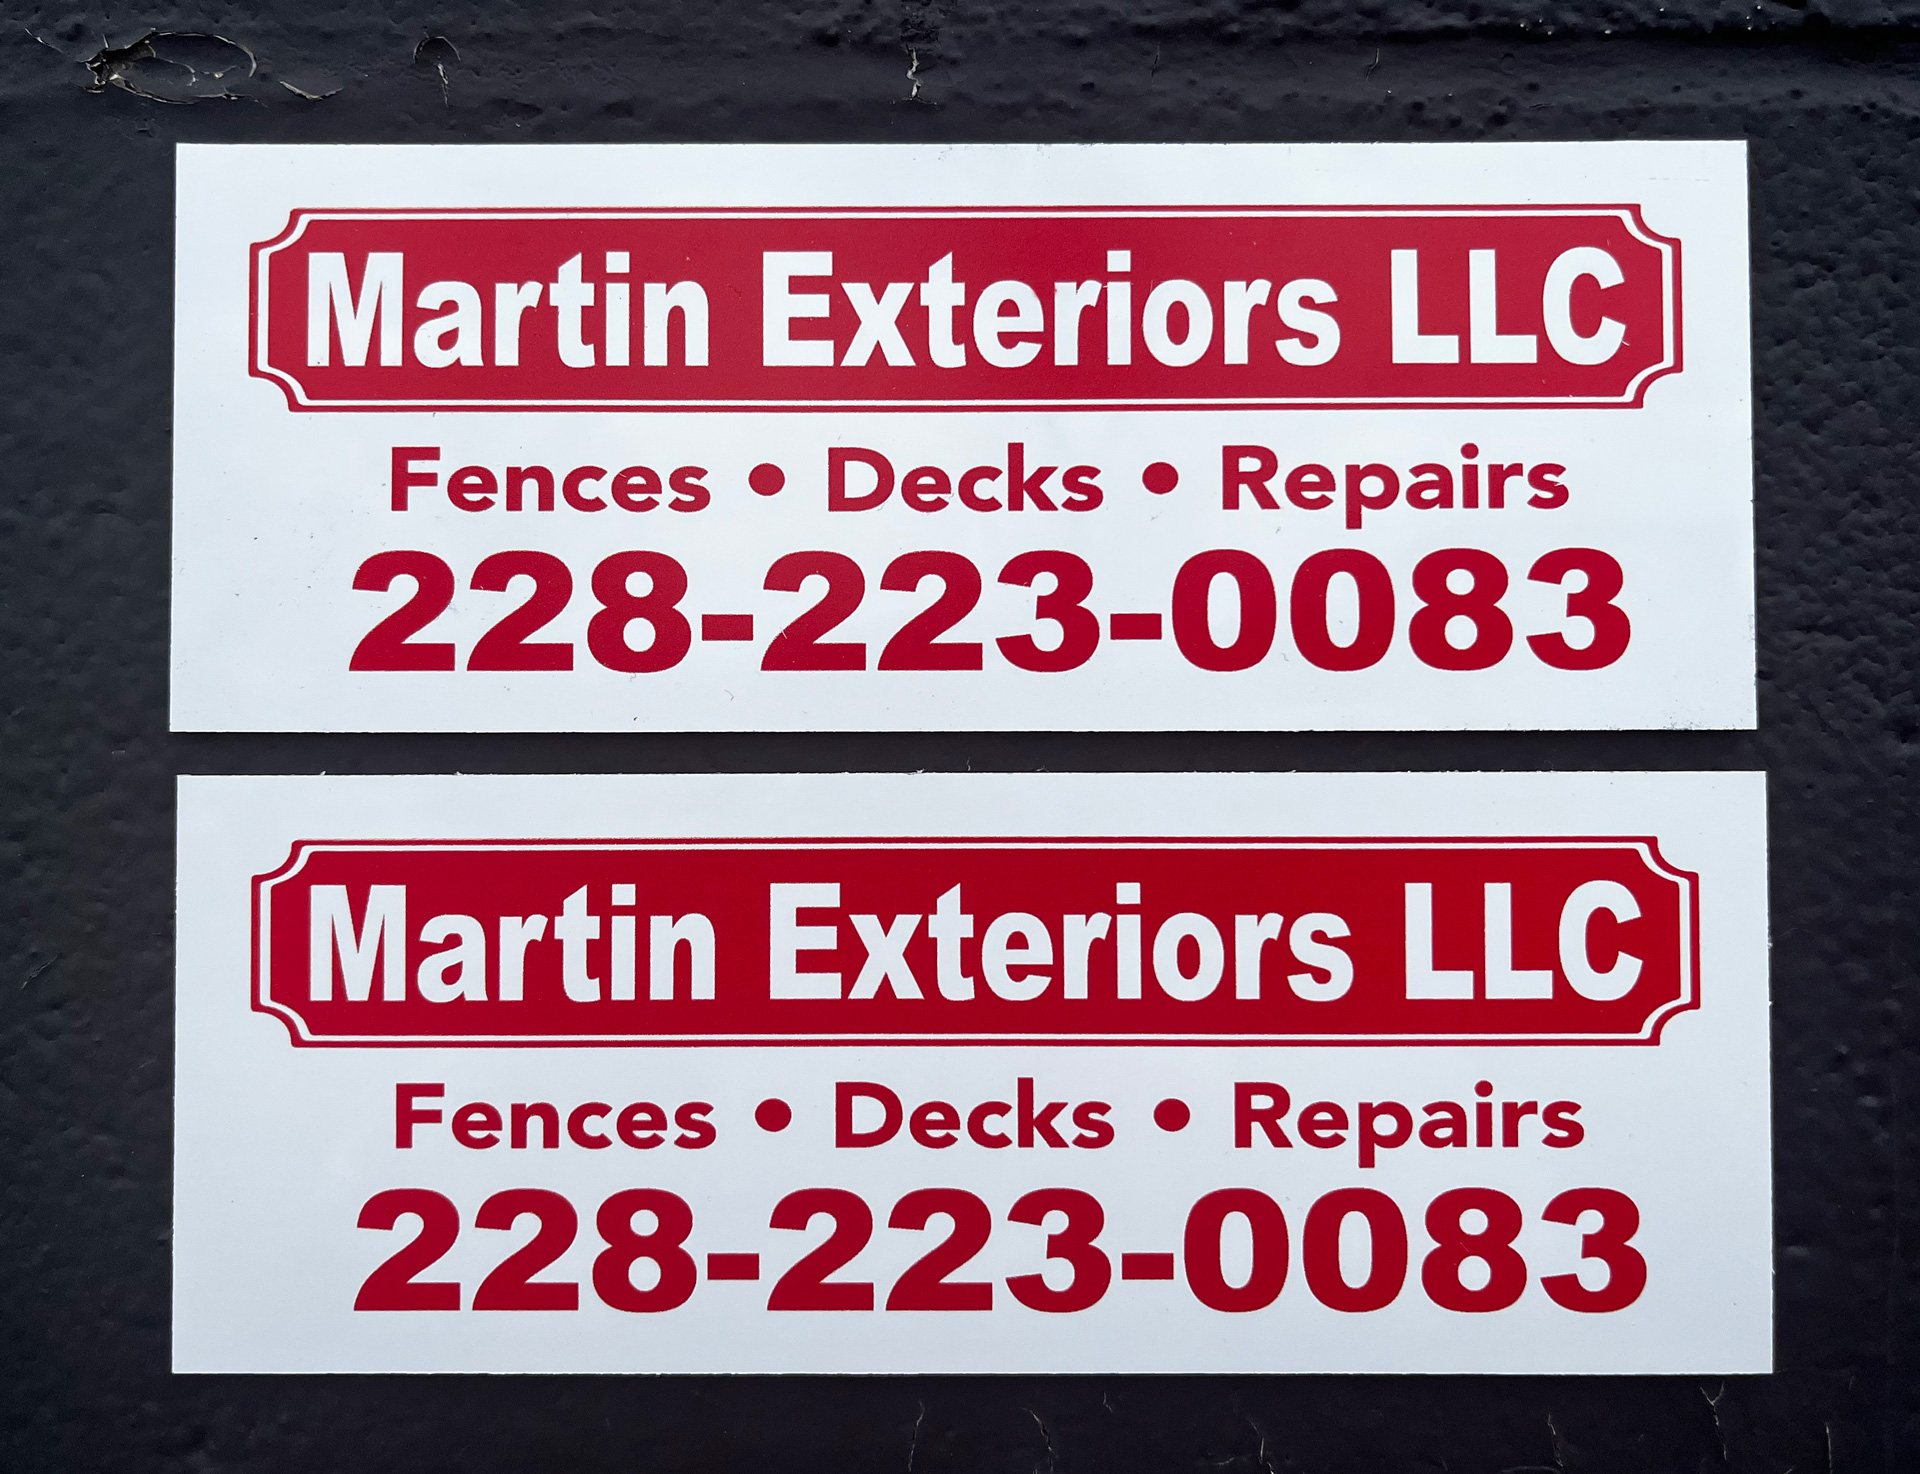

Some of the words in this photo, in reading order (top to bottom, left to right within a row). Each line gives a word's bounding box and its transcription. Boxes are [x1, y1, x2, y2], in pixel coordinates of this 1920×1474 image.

[307, 250, 710, 368] Martin
[762, 249, 1341, 368] Exteriors
[1391, 246, 1630, 366] LLC
[391, 446, 711, 513] Fences
[828, 442, 1104, 513] Decks
[1222, 442, 1570, 530] Repairs
[348, 547, 1631, 674] 228-223-0083
[309, 883, 716, 1003] Martin
[769, 882, 1354, 1002] Exteriors
[1404, 879, 1645, 1002] LLC
[395, 1083, 717, 1150] Fences
[835, 1077, 1115, 1149] Decks
[1234, 1080, 1585, 1169] Repairs
[353, 1187, 1648, 1314] 228-223-0083
